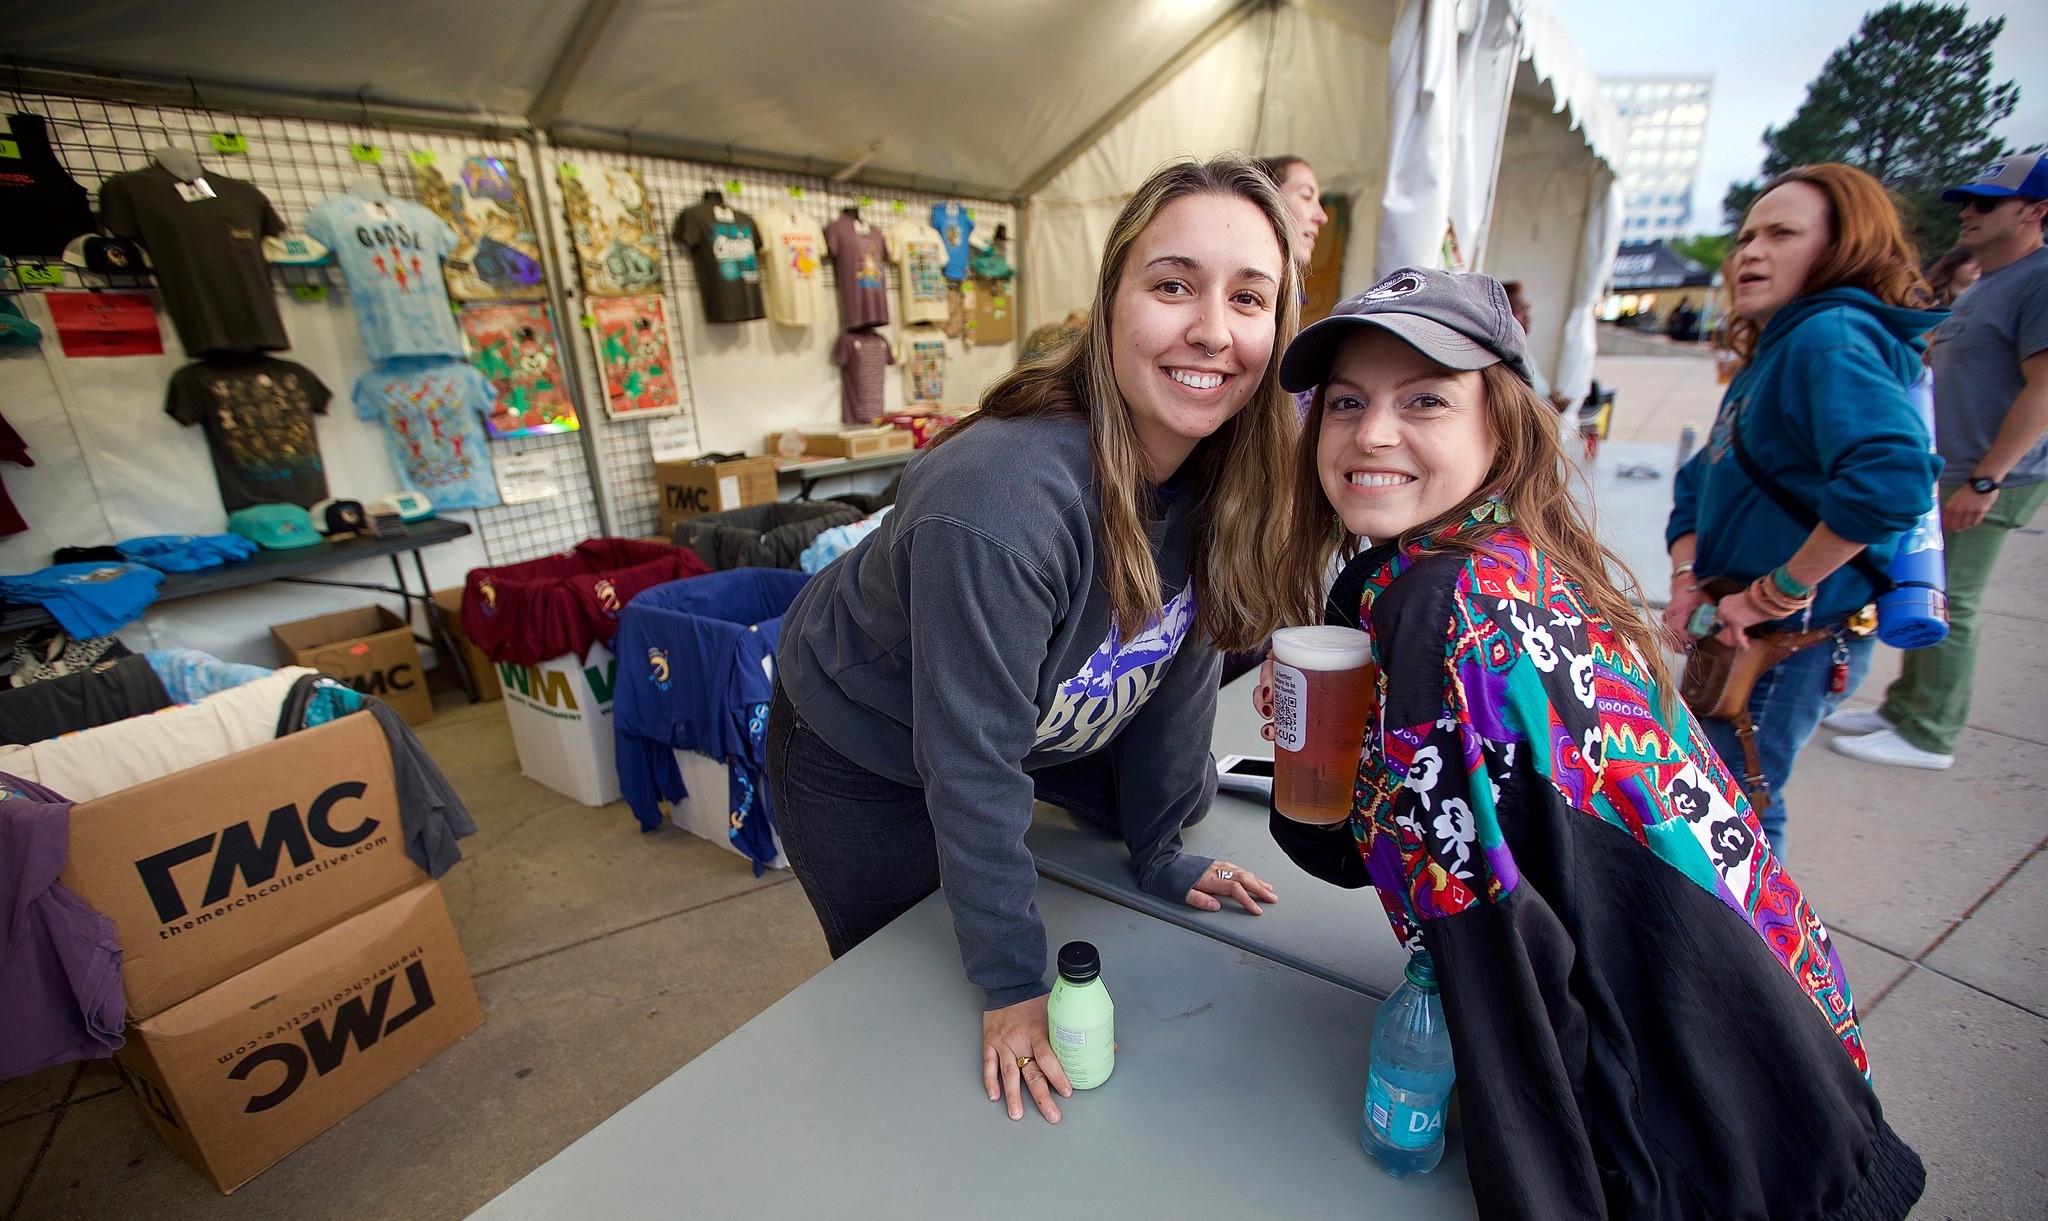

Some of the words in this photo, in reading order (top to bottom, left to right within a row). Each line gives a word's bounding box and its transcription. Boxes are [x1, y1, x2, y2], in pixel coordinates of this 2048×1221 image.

[355, 221, 424, 251] GOOSE
[342, 661, 415, 695] MC
[134, 781, 380, 924] TMC
[159, 834, 388, 940] themerchcollective.com
[217, 946, 424, 1065] themerchcollective.com
[227, 960, 436, 1114] TMC
